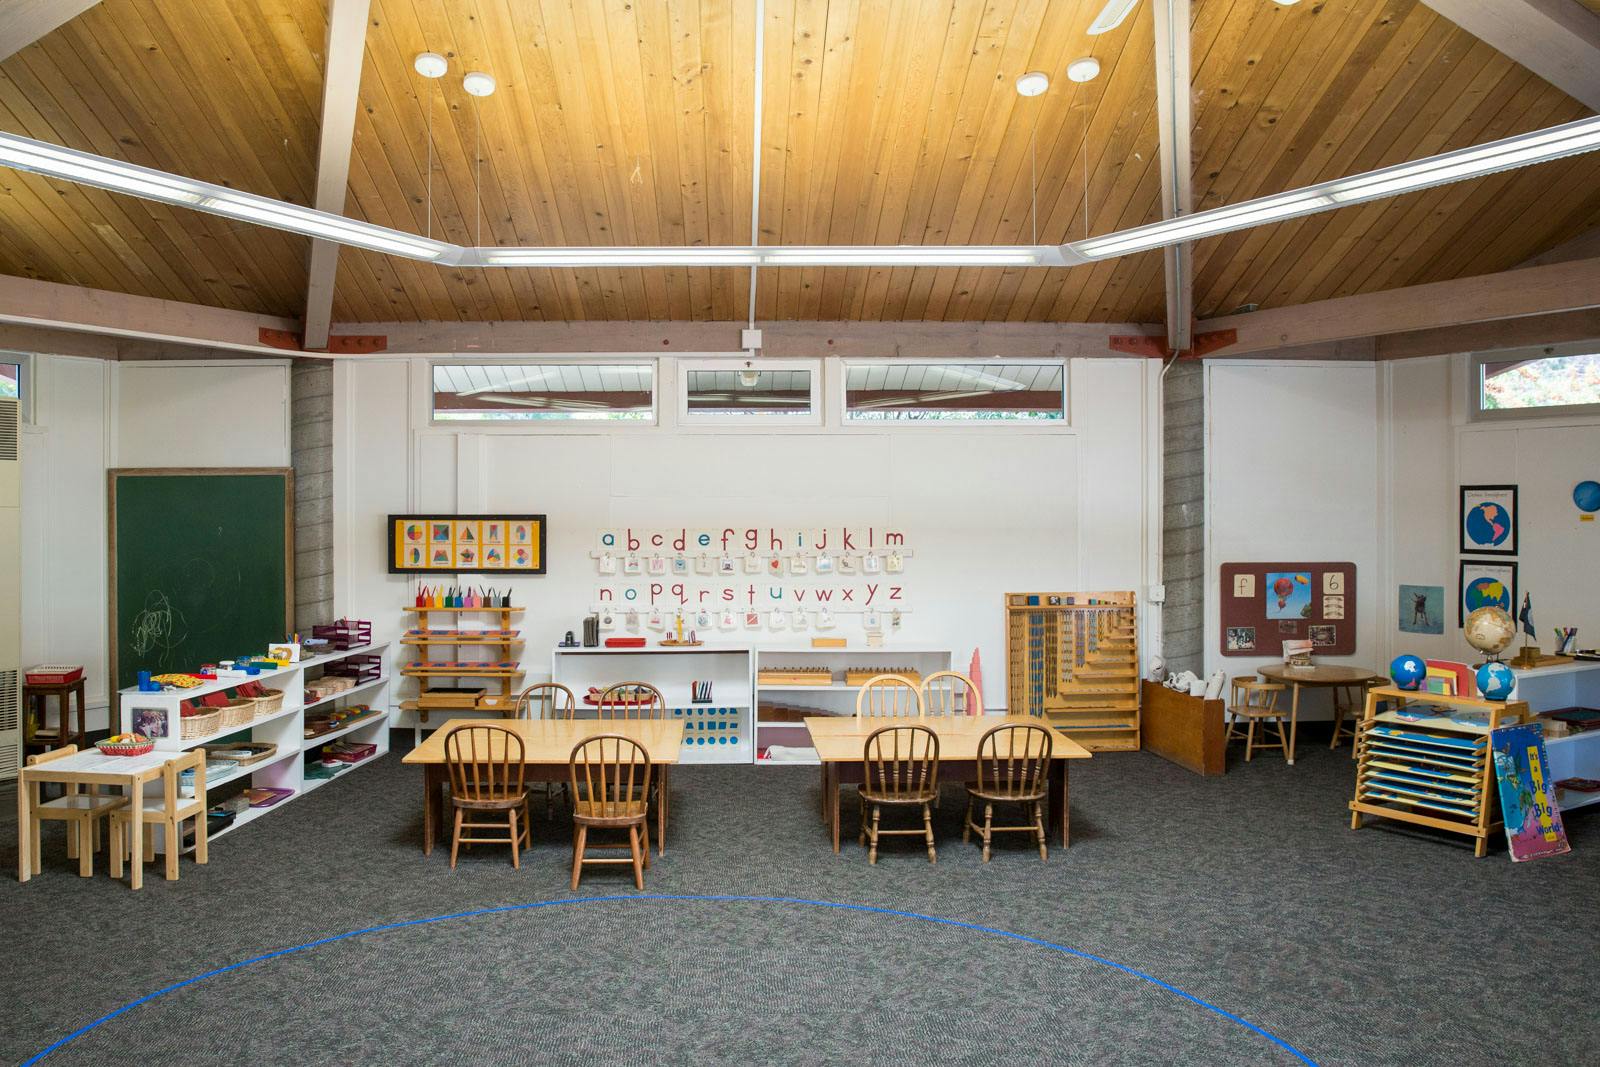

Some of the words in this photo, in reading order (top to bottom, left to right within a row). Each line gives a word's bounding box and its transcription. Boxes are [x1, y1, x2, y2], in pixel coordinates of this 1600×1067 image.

[602, 533, 614, 546] a
[628, 528, 640, 551] b
[651, 533, 664, 546] c
[673, 529, 685, 551] d
[698, 533, 710, 546] e
[721, 528, 734, 551] f
[745, 529, 757, 550] g
[771, 528, 782, 550] h
[798, 532, 802, 547] i
[815, 528, 827, 550] j
[844, 528, 856, 550] k
[869, 528, 873, 547] l
[886, 532, 904, 546] m
[1239, 577, 1248, 595] f
[1329, 574, 1340, 590] 6
[600, 588, 612, 601] n
[625, 588, 637, 600] o
[650, 584, 663, 606] p
[671, 584, 688, 605] q
[699, 589, 710, 602] r
[722, 588, 734, 601] s
[748, 584, 756, 605] t
[770, 586, 782, 600] u
[794, 589, 805, 602] v
[815, 589, 833, 602] w
[842, 588, 854, 601] x
[865, 584, 878, 606] y
[890, 586, 902, 600] z
[1529, 752, 1538, 761] It's
[1531, 780, 1547, 794] Big
[1534, 802, 1552, 817] Big
